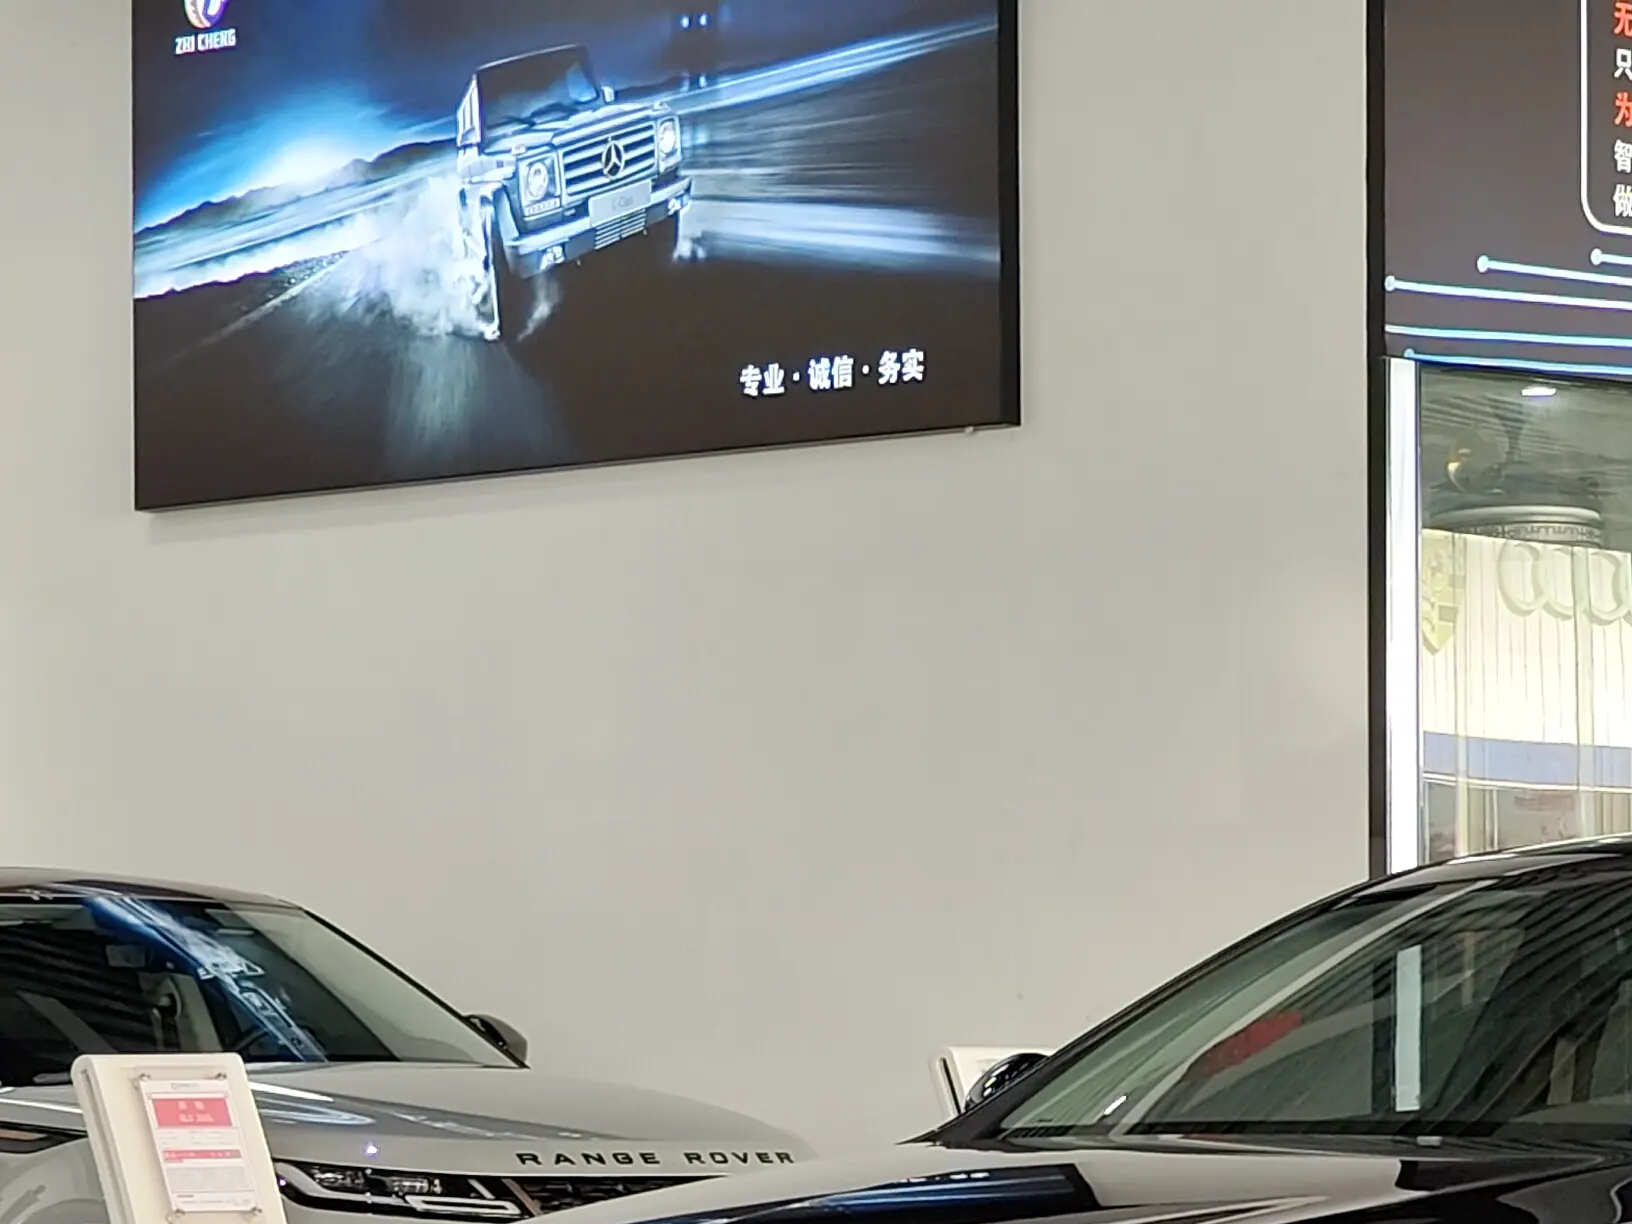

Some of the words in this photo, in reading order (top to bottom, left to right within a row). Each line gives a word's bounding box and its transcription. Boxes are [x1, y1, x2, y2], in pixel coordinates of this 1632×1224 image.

[197, 28, 237, 52] CHENG
[515, 1151, 660, 1166] RANGE
[683, 1151, 794, 1165] ROVER
